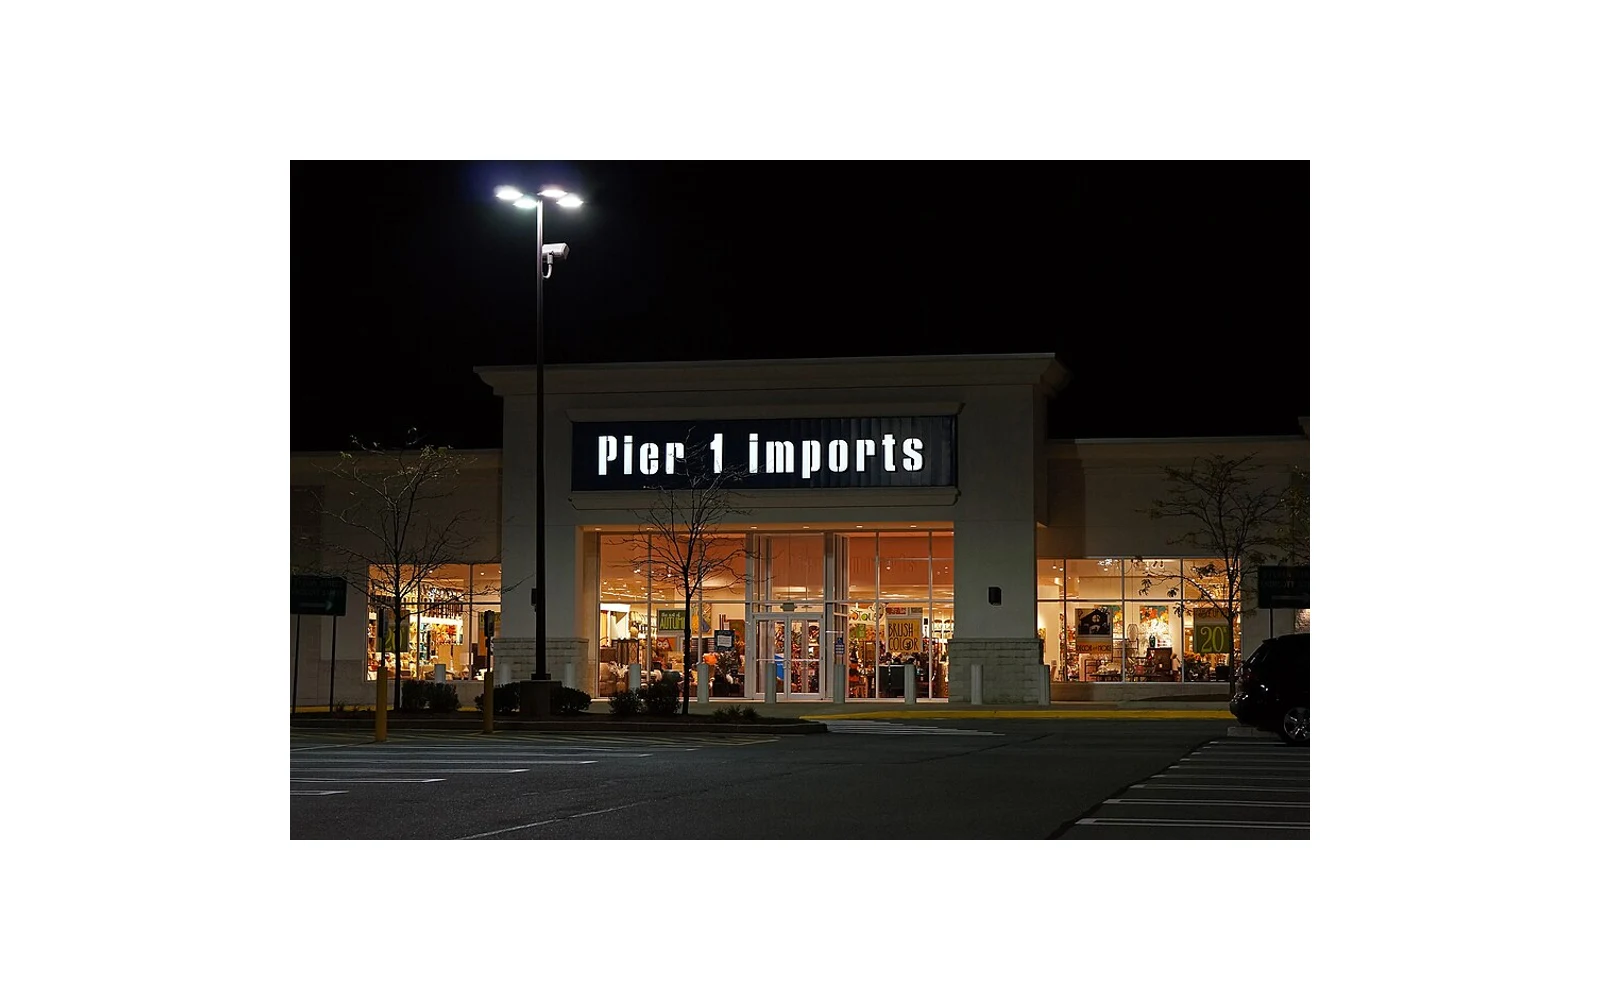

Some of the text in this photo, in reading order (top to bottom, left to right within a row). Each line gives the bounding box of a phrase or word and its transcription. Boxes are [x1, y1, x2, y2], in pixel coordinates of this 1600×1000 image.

[598, 432, 924, 479] Pier 1 imports
[888, 622, 914, 637] BRUSH
